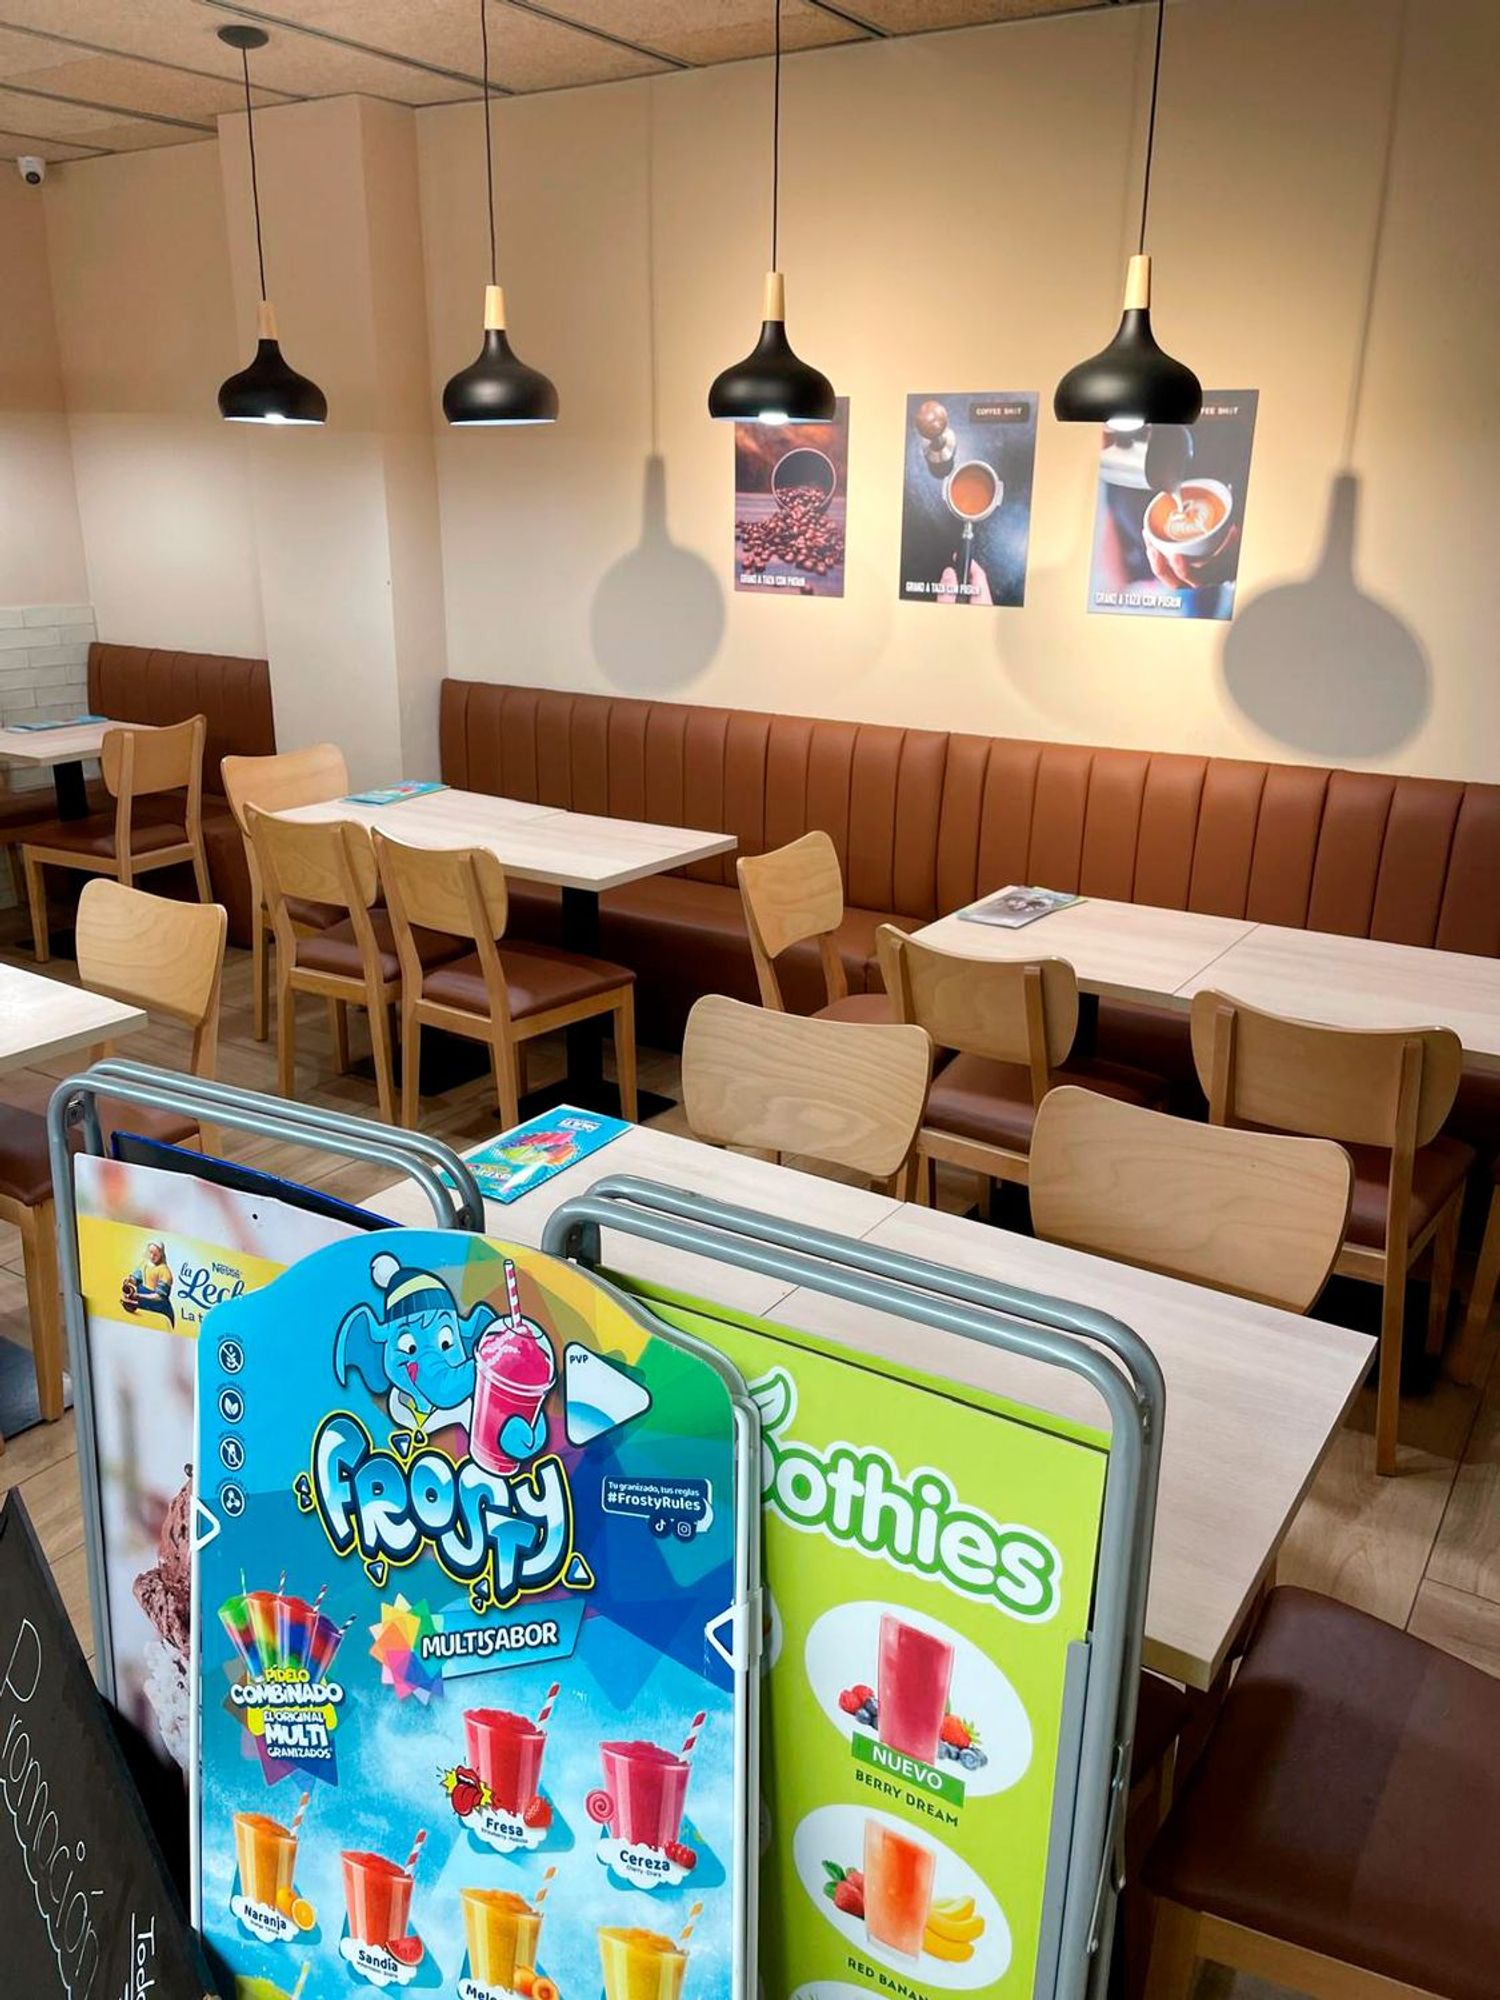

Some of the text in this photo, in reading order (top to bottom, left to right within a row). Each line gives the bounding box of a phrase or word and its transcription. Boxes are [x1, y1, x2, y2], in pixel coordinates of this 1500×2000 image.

[181, 1307, 195, 1322] La
[569, 1354, 589, 1364] PVP
[608, 1481, 619, 1490] Tu
[661, 1486, 674, 1494] tus
[674, 1487, 700, 1497] reglas
[607, 1491, 701, 1511] #FrostyRules
[761, 1437, 1056, 1616] othies
[422, 1621, 557, 1658] MULTISABOR
[274, 1711, 324, 1722] ORIGINAL
[265, 1723, 328, 1746] MULTI
[267, 1747, 331, 1759] GRANIZADOS
[872, 1745, 943, 1790] NUEVO
[855, 1769, 959, 1828] BERRY DREAM
[486, 1817, 523, 1837] Fresa
[620, 1849, 670, 1871] Cereza
[244, 1904, 287, 1930] Naranja
[136, 1913, 156, 2000] Tod
[848, 1956, 875, 1978] RED
